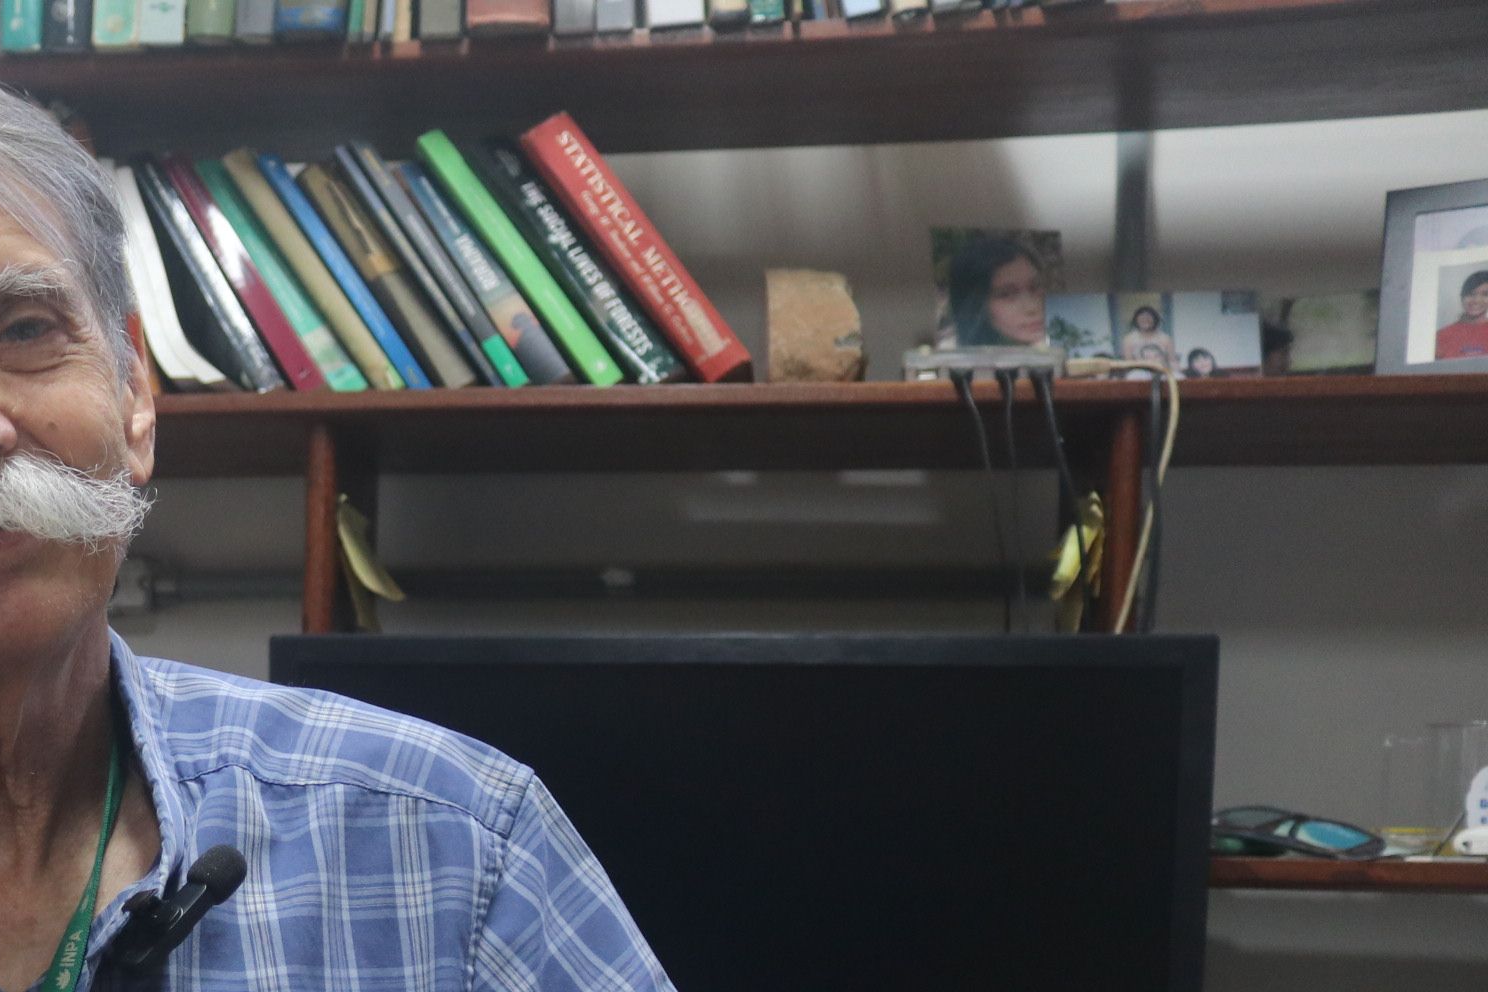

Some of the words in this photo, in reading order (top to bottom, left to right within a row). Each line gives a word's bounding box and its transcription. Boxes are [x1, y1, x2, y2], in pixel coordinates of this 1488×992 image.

[520, 181, 546, 207] THE
[556, 130, 644, 246] STATISTICAL
[536, 203, 577, 250] SOCIAL
[567, 246, 603, 285] LIVES
[592, 280, 616, 300] OF
[603, 297, 653, 356] FORESTS
[59, 930, 83, 968] INPA
